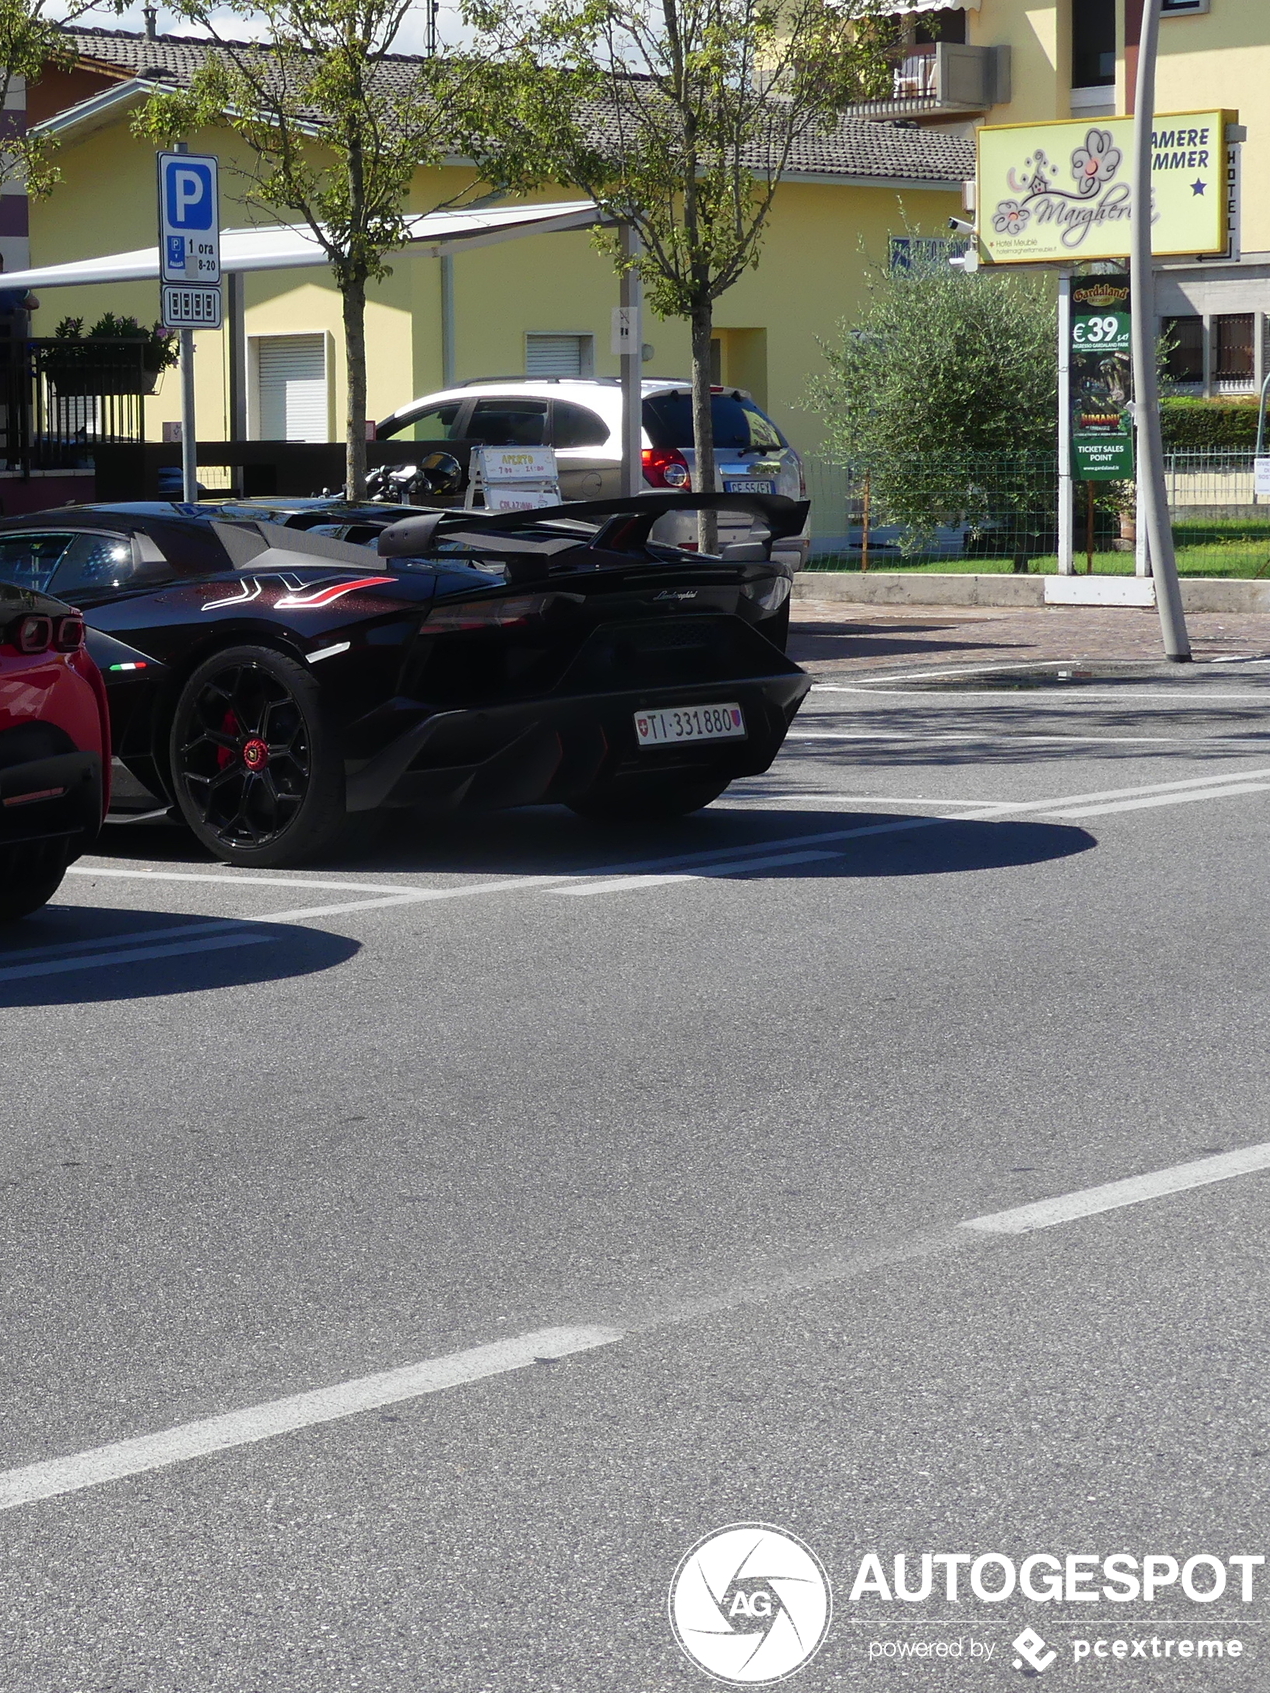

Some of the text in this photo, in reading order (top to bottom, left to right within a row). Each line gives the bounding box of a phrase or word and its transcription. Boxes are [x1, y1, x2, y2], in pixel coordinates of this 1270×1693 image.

[1151, 128, 1209, 149] AMERE
[1151, 150, 1209, 170] MMER
[175, 169, 203, 222] P
[1227, 150, 1236, 231] HOTEL
[189, 239, 214, 254] 1 ora
[996, 240, 1012, 248] Hotel
[198, 259, 216, 271] 8-20
[1074, 284, 1129, 301] Gardaland
[1078, 445, 1124, 453] TICKET SALES
[502, 454, 534, 465] APERTO
